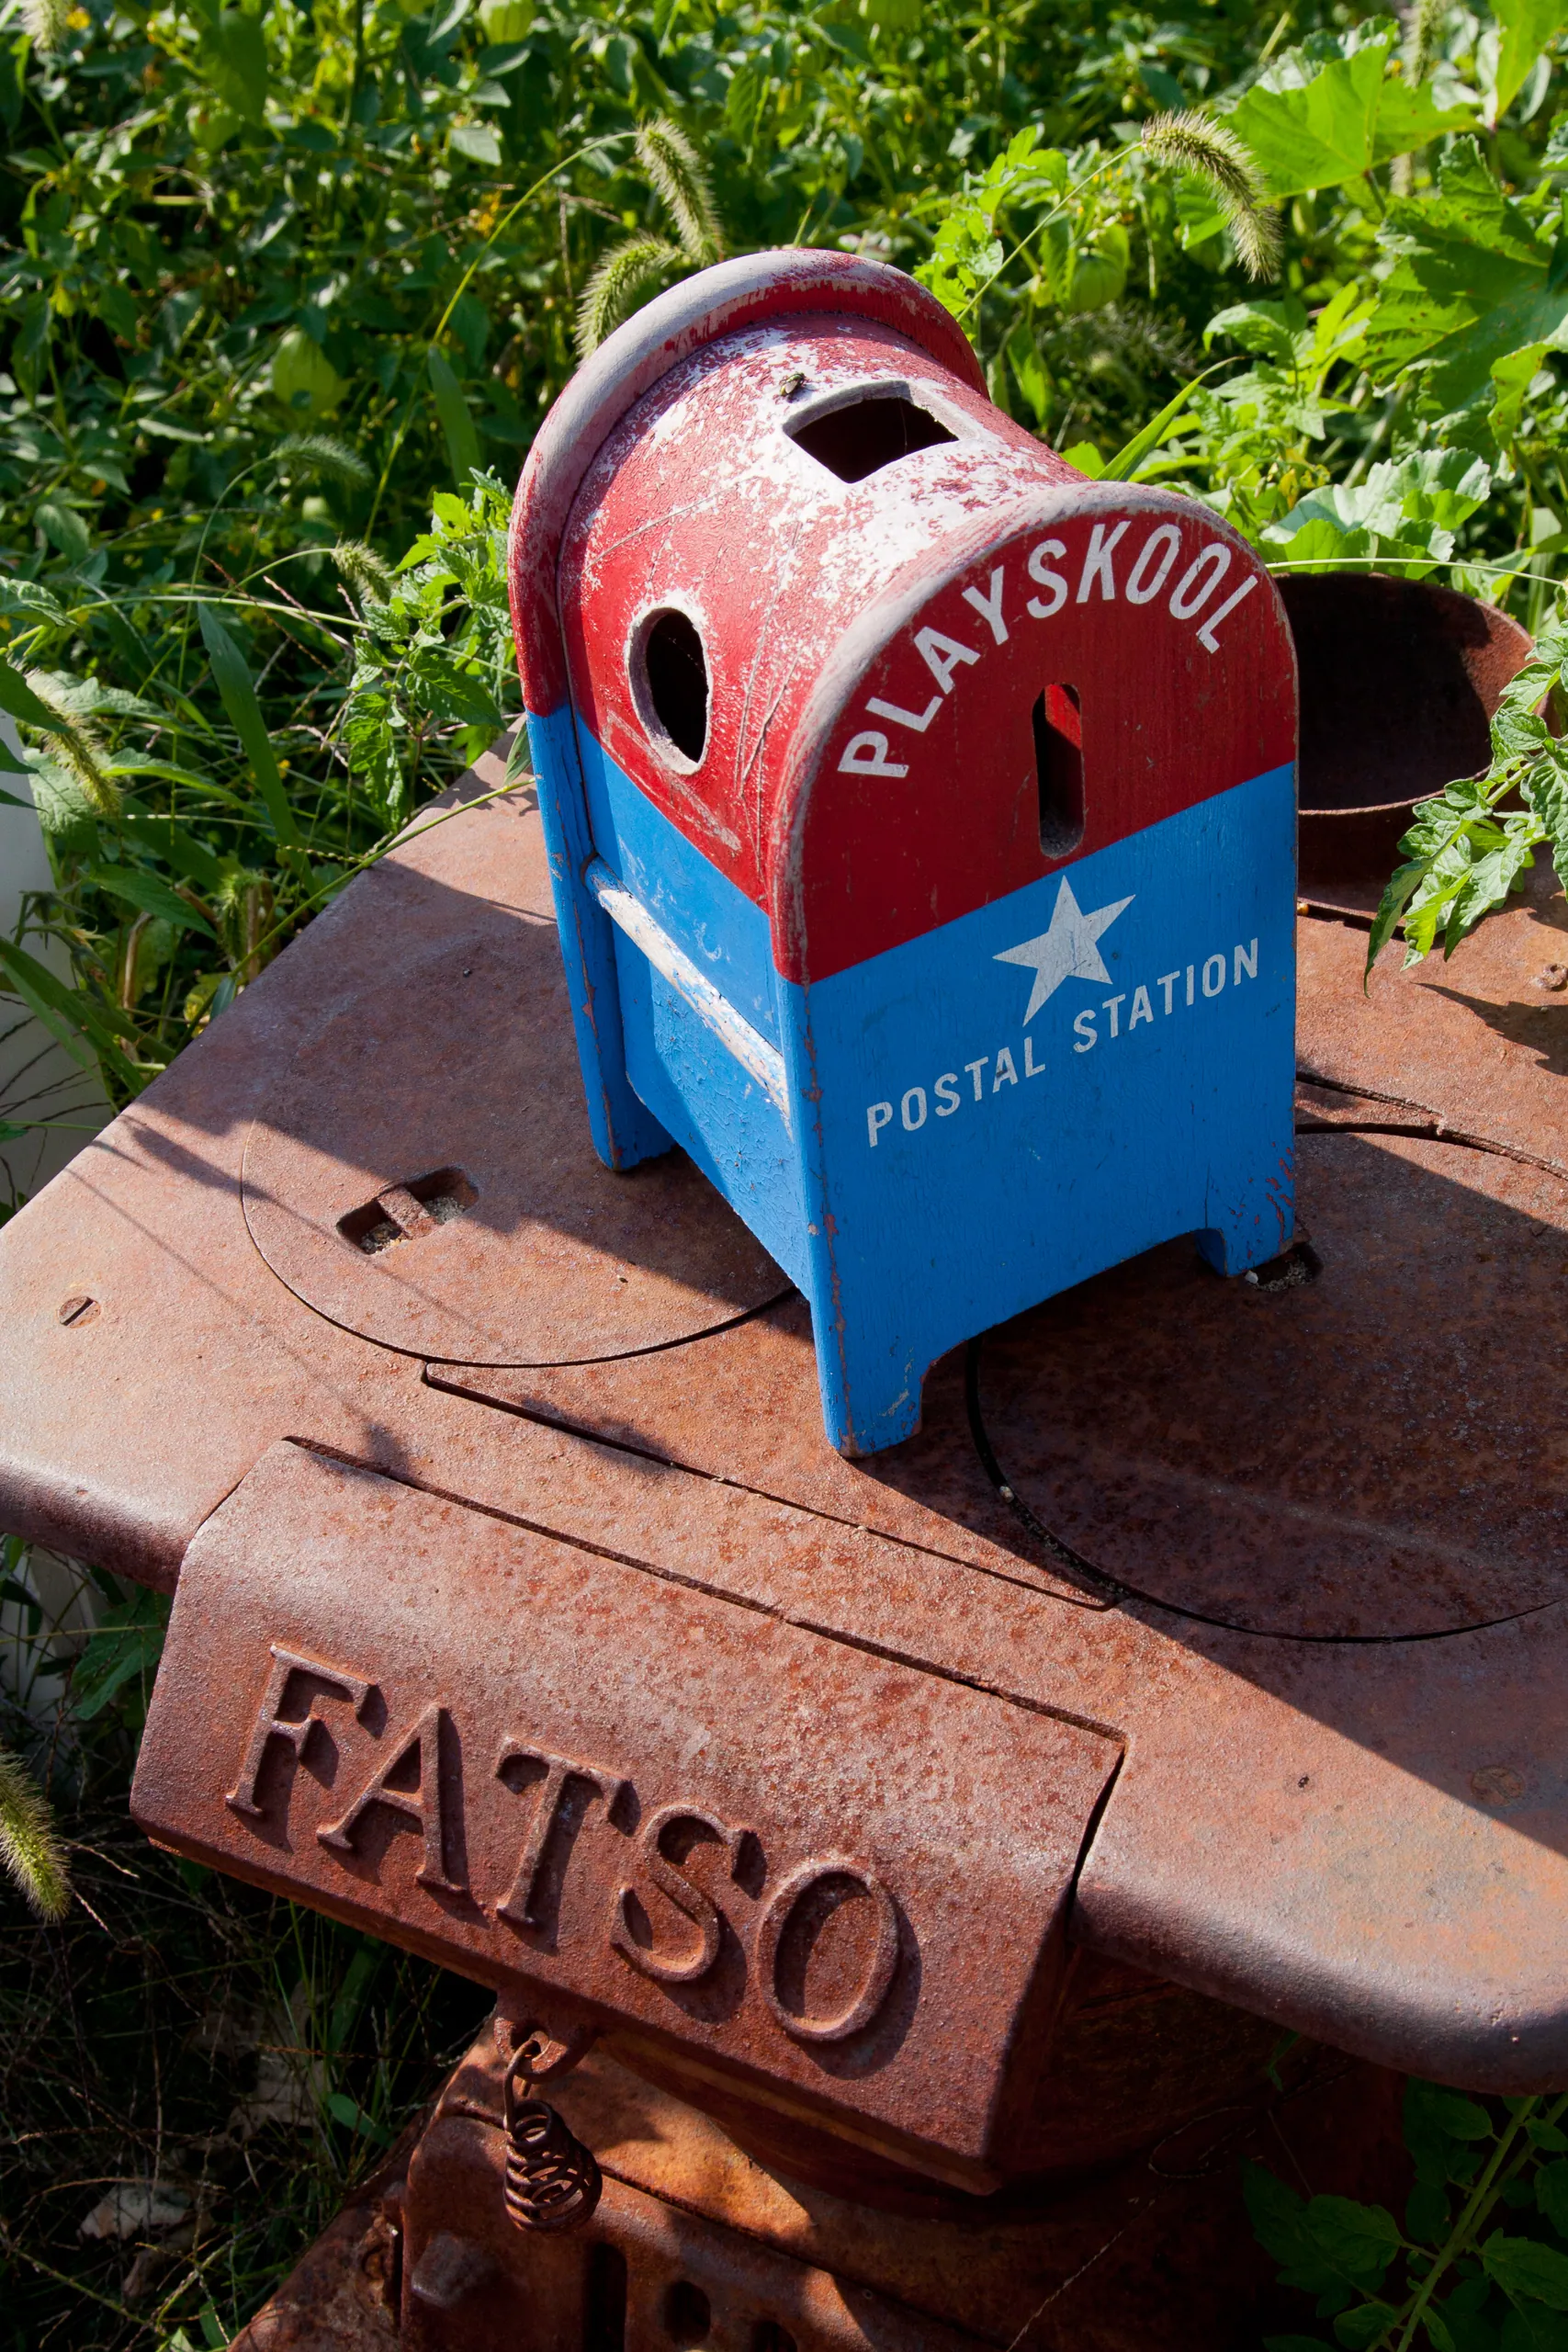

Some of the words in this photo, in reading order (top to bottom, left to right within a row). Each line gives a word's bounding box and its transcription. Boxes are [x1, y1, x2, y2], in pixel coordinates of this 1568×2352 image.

[837, 520, 1258, 778] PLAYSKOOL
[866, 1035, 1046, 1148] POSTAL
[1072, 937, 1260, 1055] STATION
[225, 1644, 901, 2042] FATSO
